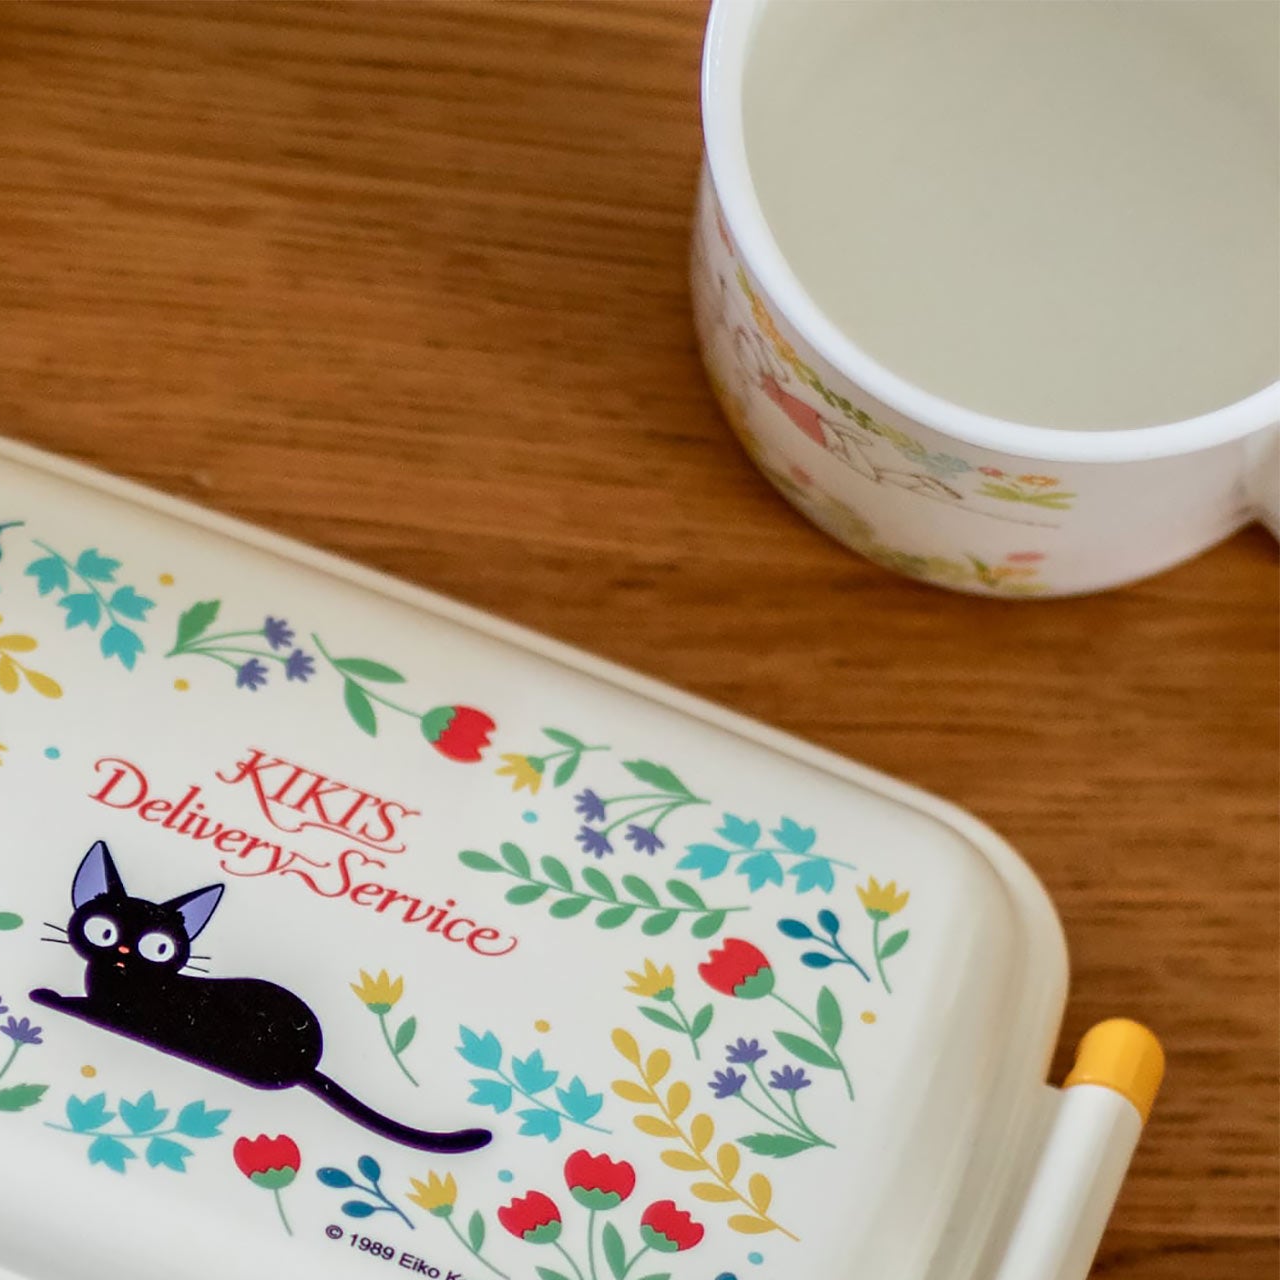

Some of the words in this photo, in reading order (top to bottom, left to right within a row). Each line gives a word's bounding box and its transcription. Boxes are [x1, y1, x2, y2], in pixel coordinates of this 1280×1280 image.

[215, 748, 421, 854] KIKI'S
[88, 757, 331, 877] Delivery
[280, 849, 518, 957] Service
[350, 1234, 395, 1261] 1989
[398, 1252, 441, 1279] Eiko
